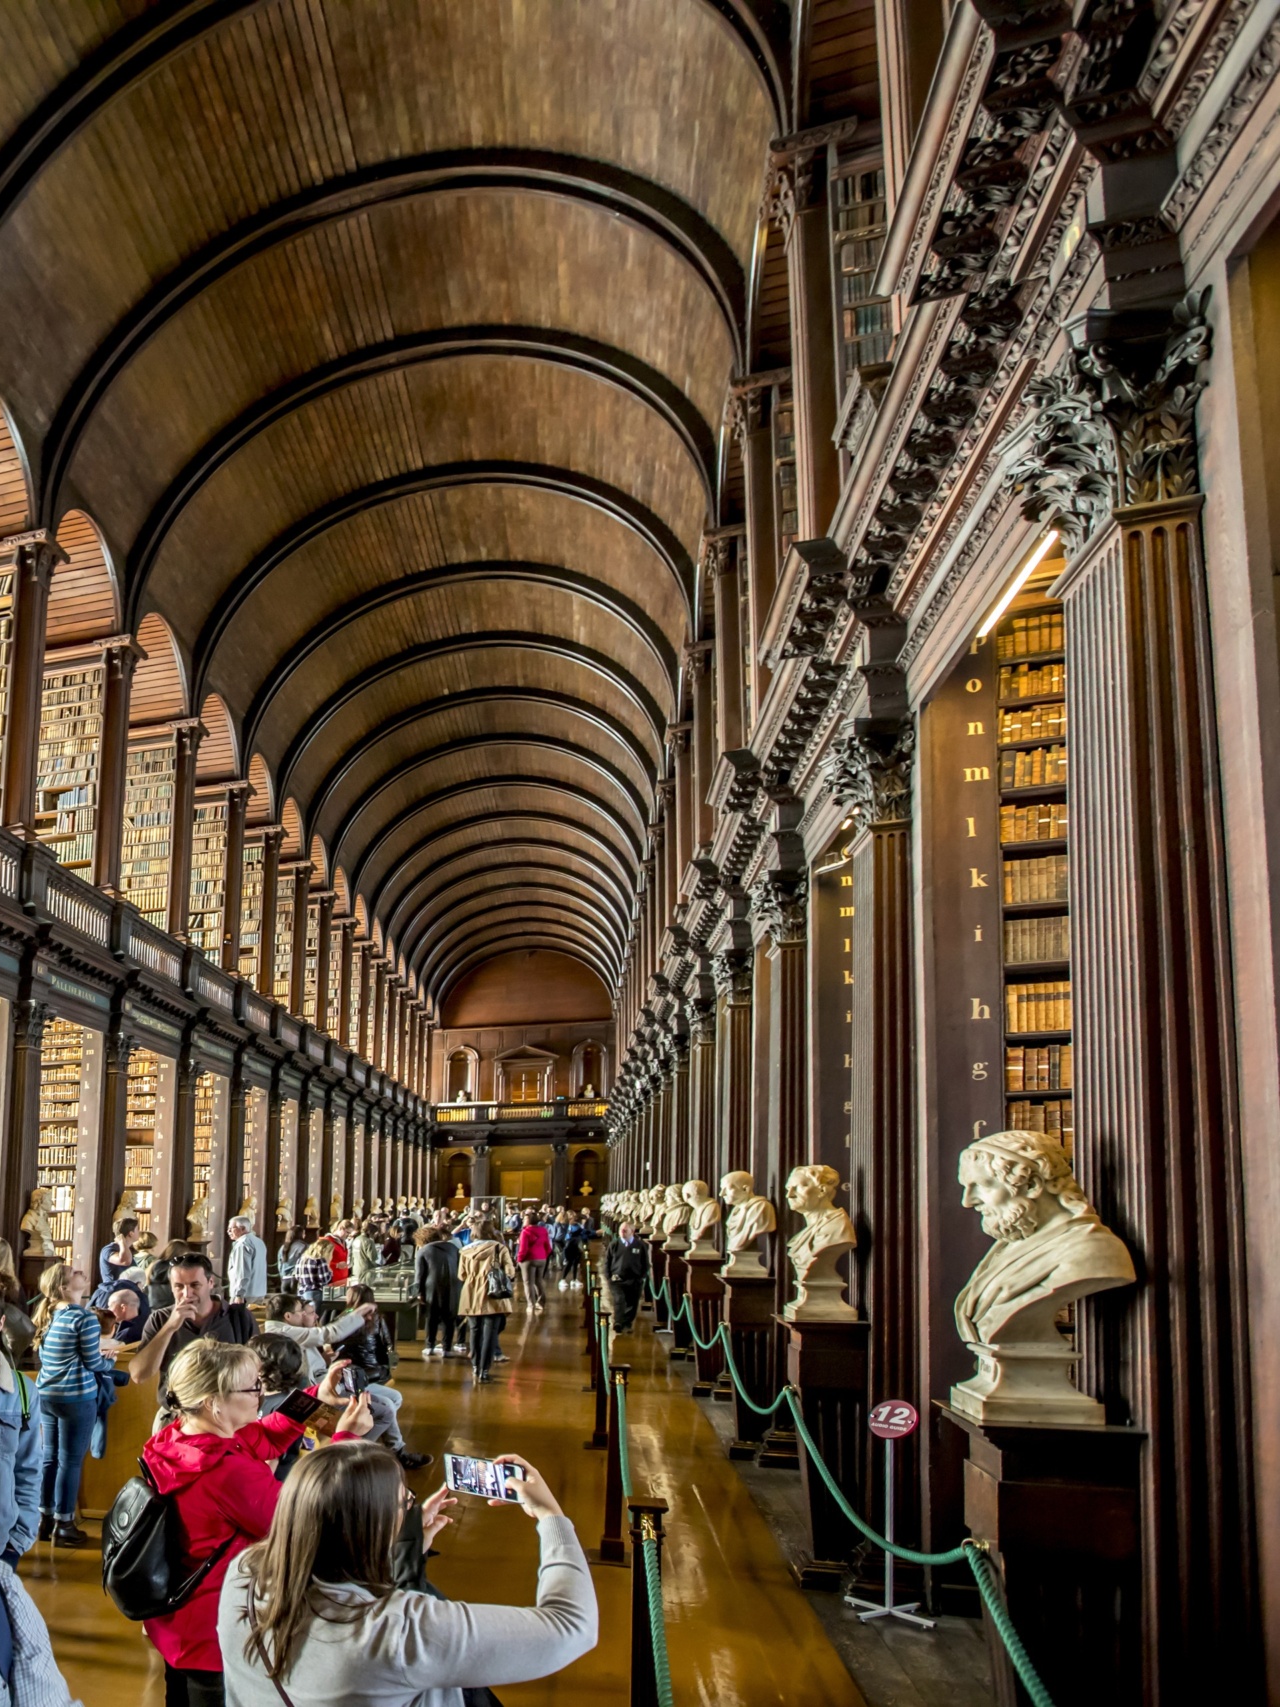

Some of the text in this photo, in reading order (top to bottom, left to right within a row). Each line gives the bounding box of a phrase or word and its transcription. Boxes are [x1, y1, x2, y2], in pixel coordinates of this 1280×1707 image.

[965, 678, 982, 693] o
[966, 721, 986, 736] n
[963, 762, 991, 783] m
[966, 816, 976, 838] l
[840, 876, 852, 887] n
[970, 868, 988, 888] k
[840, 906, 854, 917] m
[973, 925, 983, 942] i
[844, 938, 850, 952] l
[844, 971, 854, 984] k
[846, 1011, 852, 1022] i
[970, 998, 991, 1020] h
[972, 1060, 988, 1081] g
[972, 1120, 986, 1140] f
[878, 1406, 910, 1424] 12
